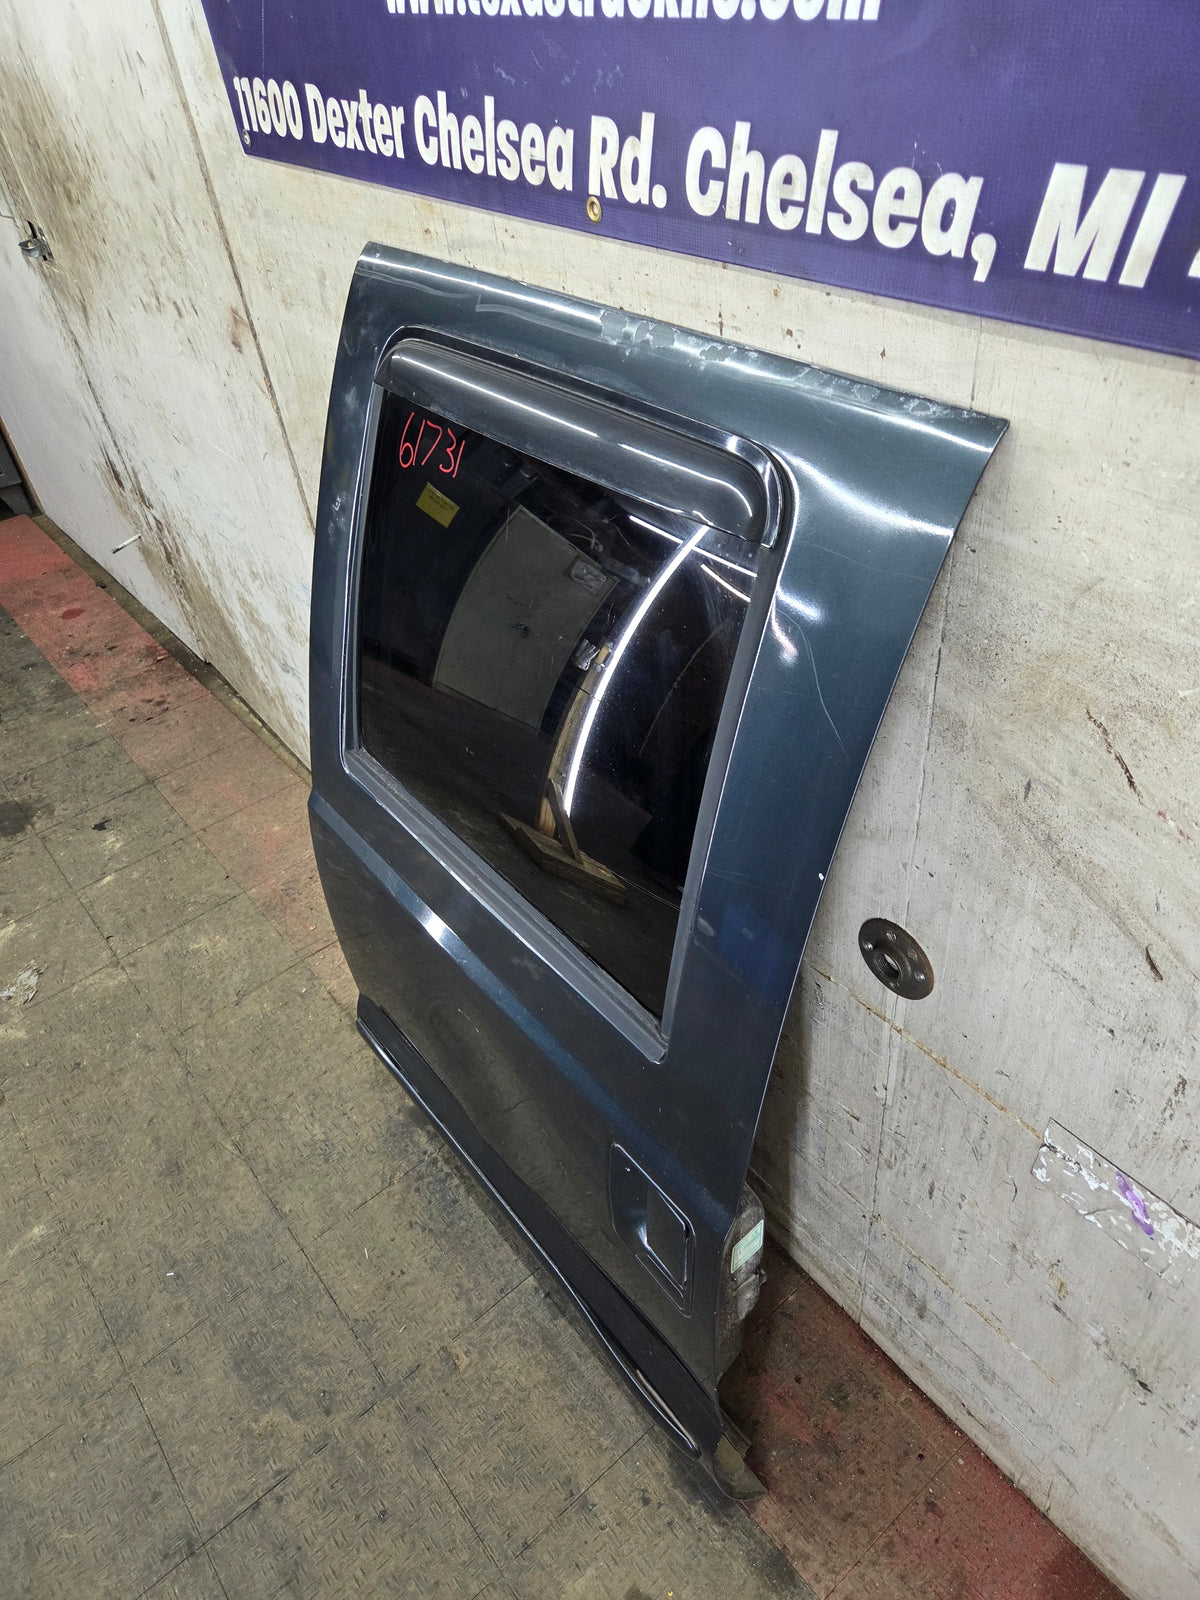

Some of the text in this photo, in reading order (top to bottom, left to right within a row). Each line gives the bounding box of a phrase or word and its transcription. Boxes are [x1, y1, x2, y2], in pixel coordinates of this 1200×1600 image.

[232, 76, 1187, 289] 11600 Dexter Chelsea Rd. Chelsea, MI
[399, 411, 466, 478] 61731
